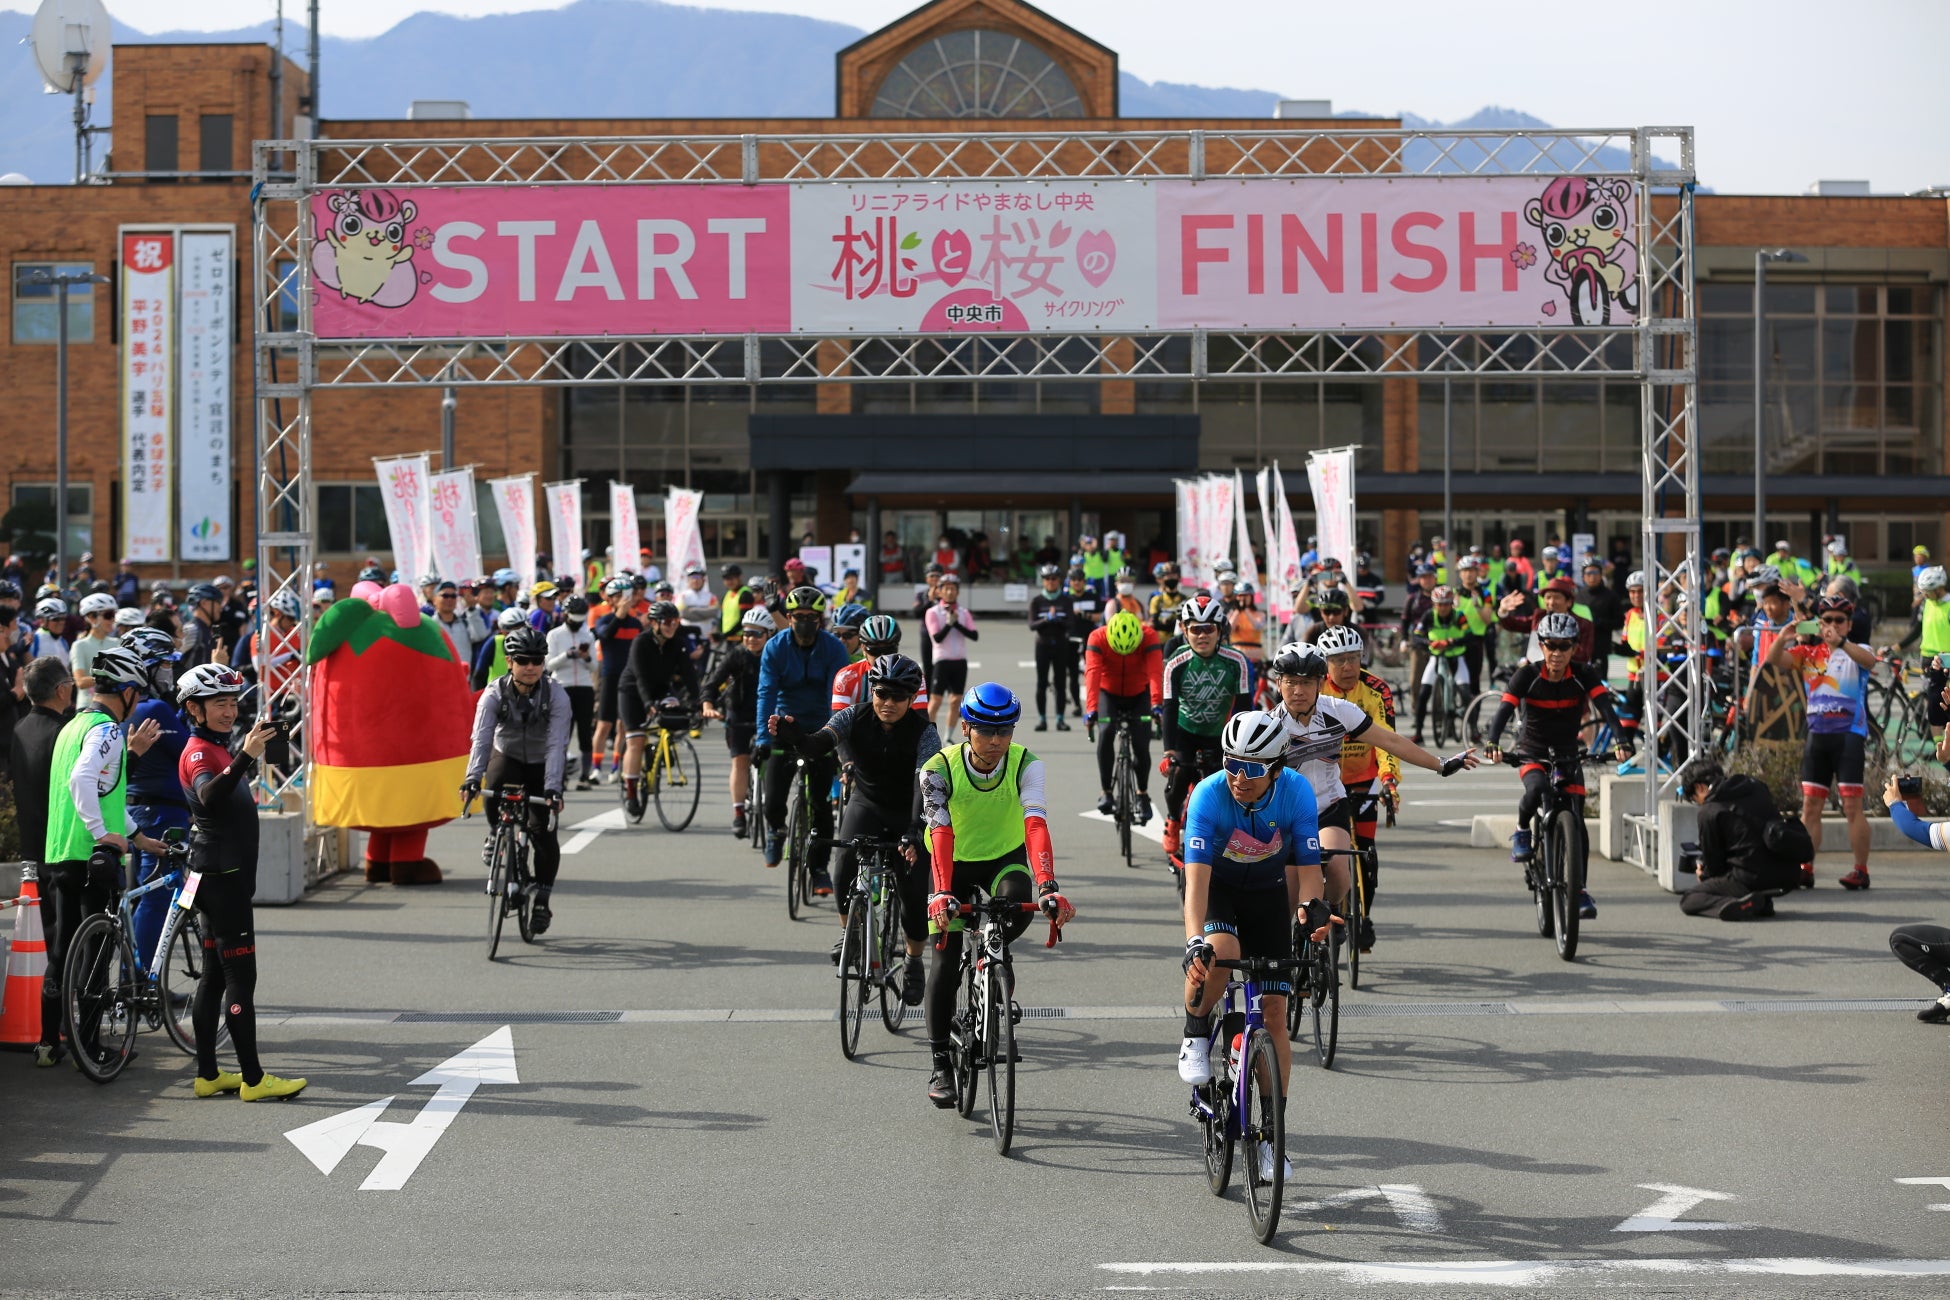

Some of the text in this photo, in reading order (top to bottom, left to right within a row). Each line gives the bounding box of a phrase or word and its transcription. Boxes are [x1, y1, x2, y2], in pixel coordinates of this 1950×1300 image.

[851, 191, 1094, 212] リニアライドやまなし中央
[134, 239, 162, 268] 祝
[429, 217, 767, 303] START
[831, 214, 1112, 300] 桃と桜の
[1181, 211, 1519, 295] FINISH
[947, 305, 1001, 323] 中央市
[1043, 299, 1125, 318] サイクリング
